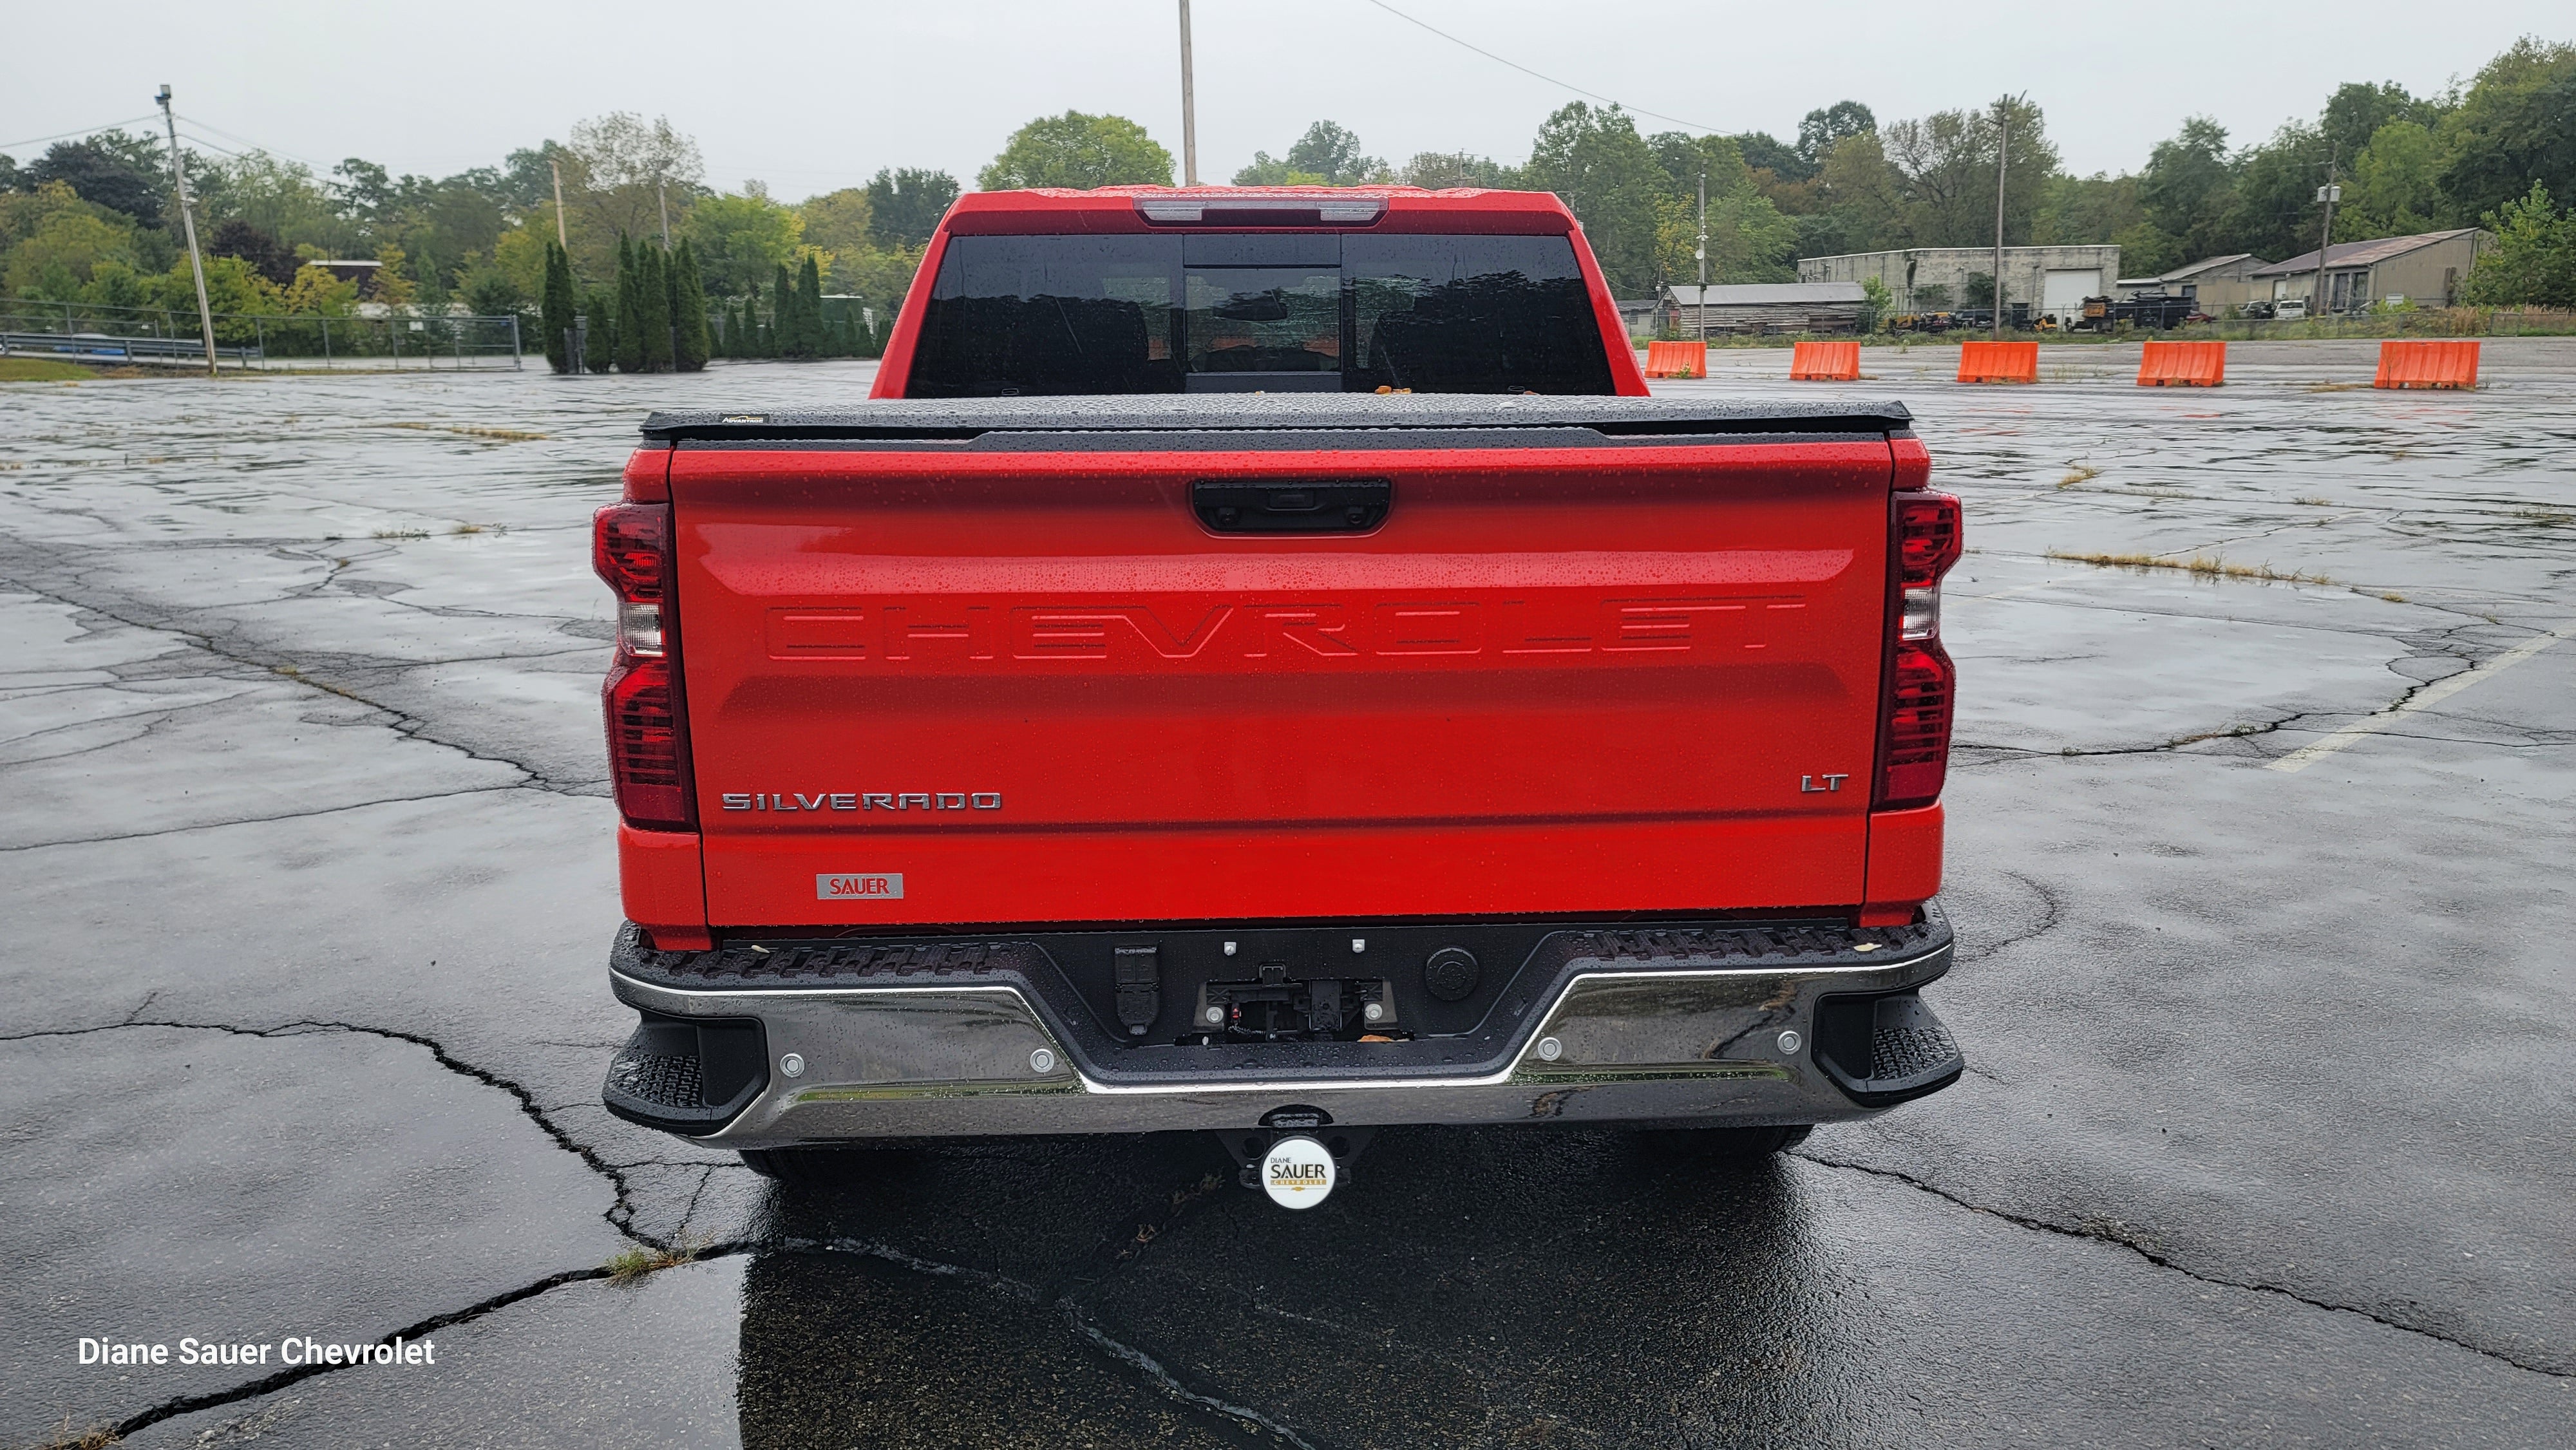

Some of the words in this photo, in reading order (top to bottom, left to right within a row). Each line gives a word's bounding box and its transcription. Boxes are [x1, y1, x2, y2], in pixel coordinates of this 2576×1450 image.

[765, 595, 1807, 659] CHEVROLET
[1801, 774, 1849, 792] LT
[722, 793, 1001, 810] SILVERADO
[829, 877, 890, 896] SAUER
[1270, 1164, 1327, 1179] SAUER
